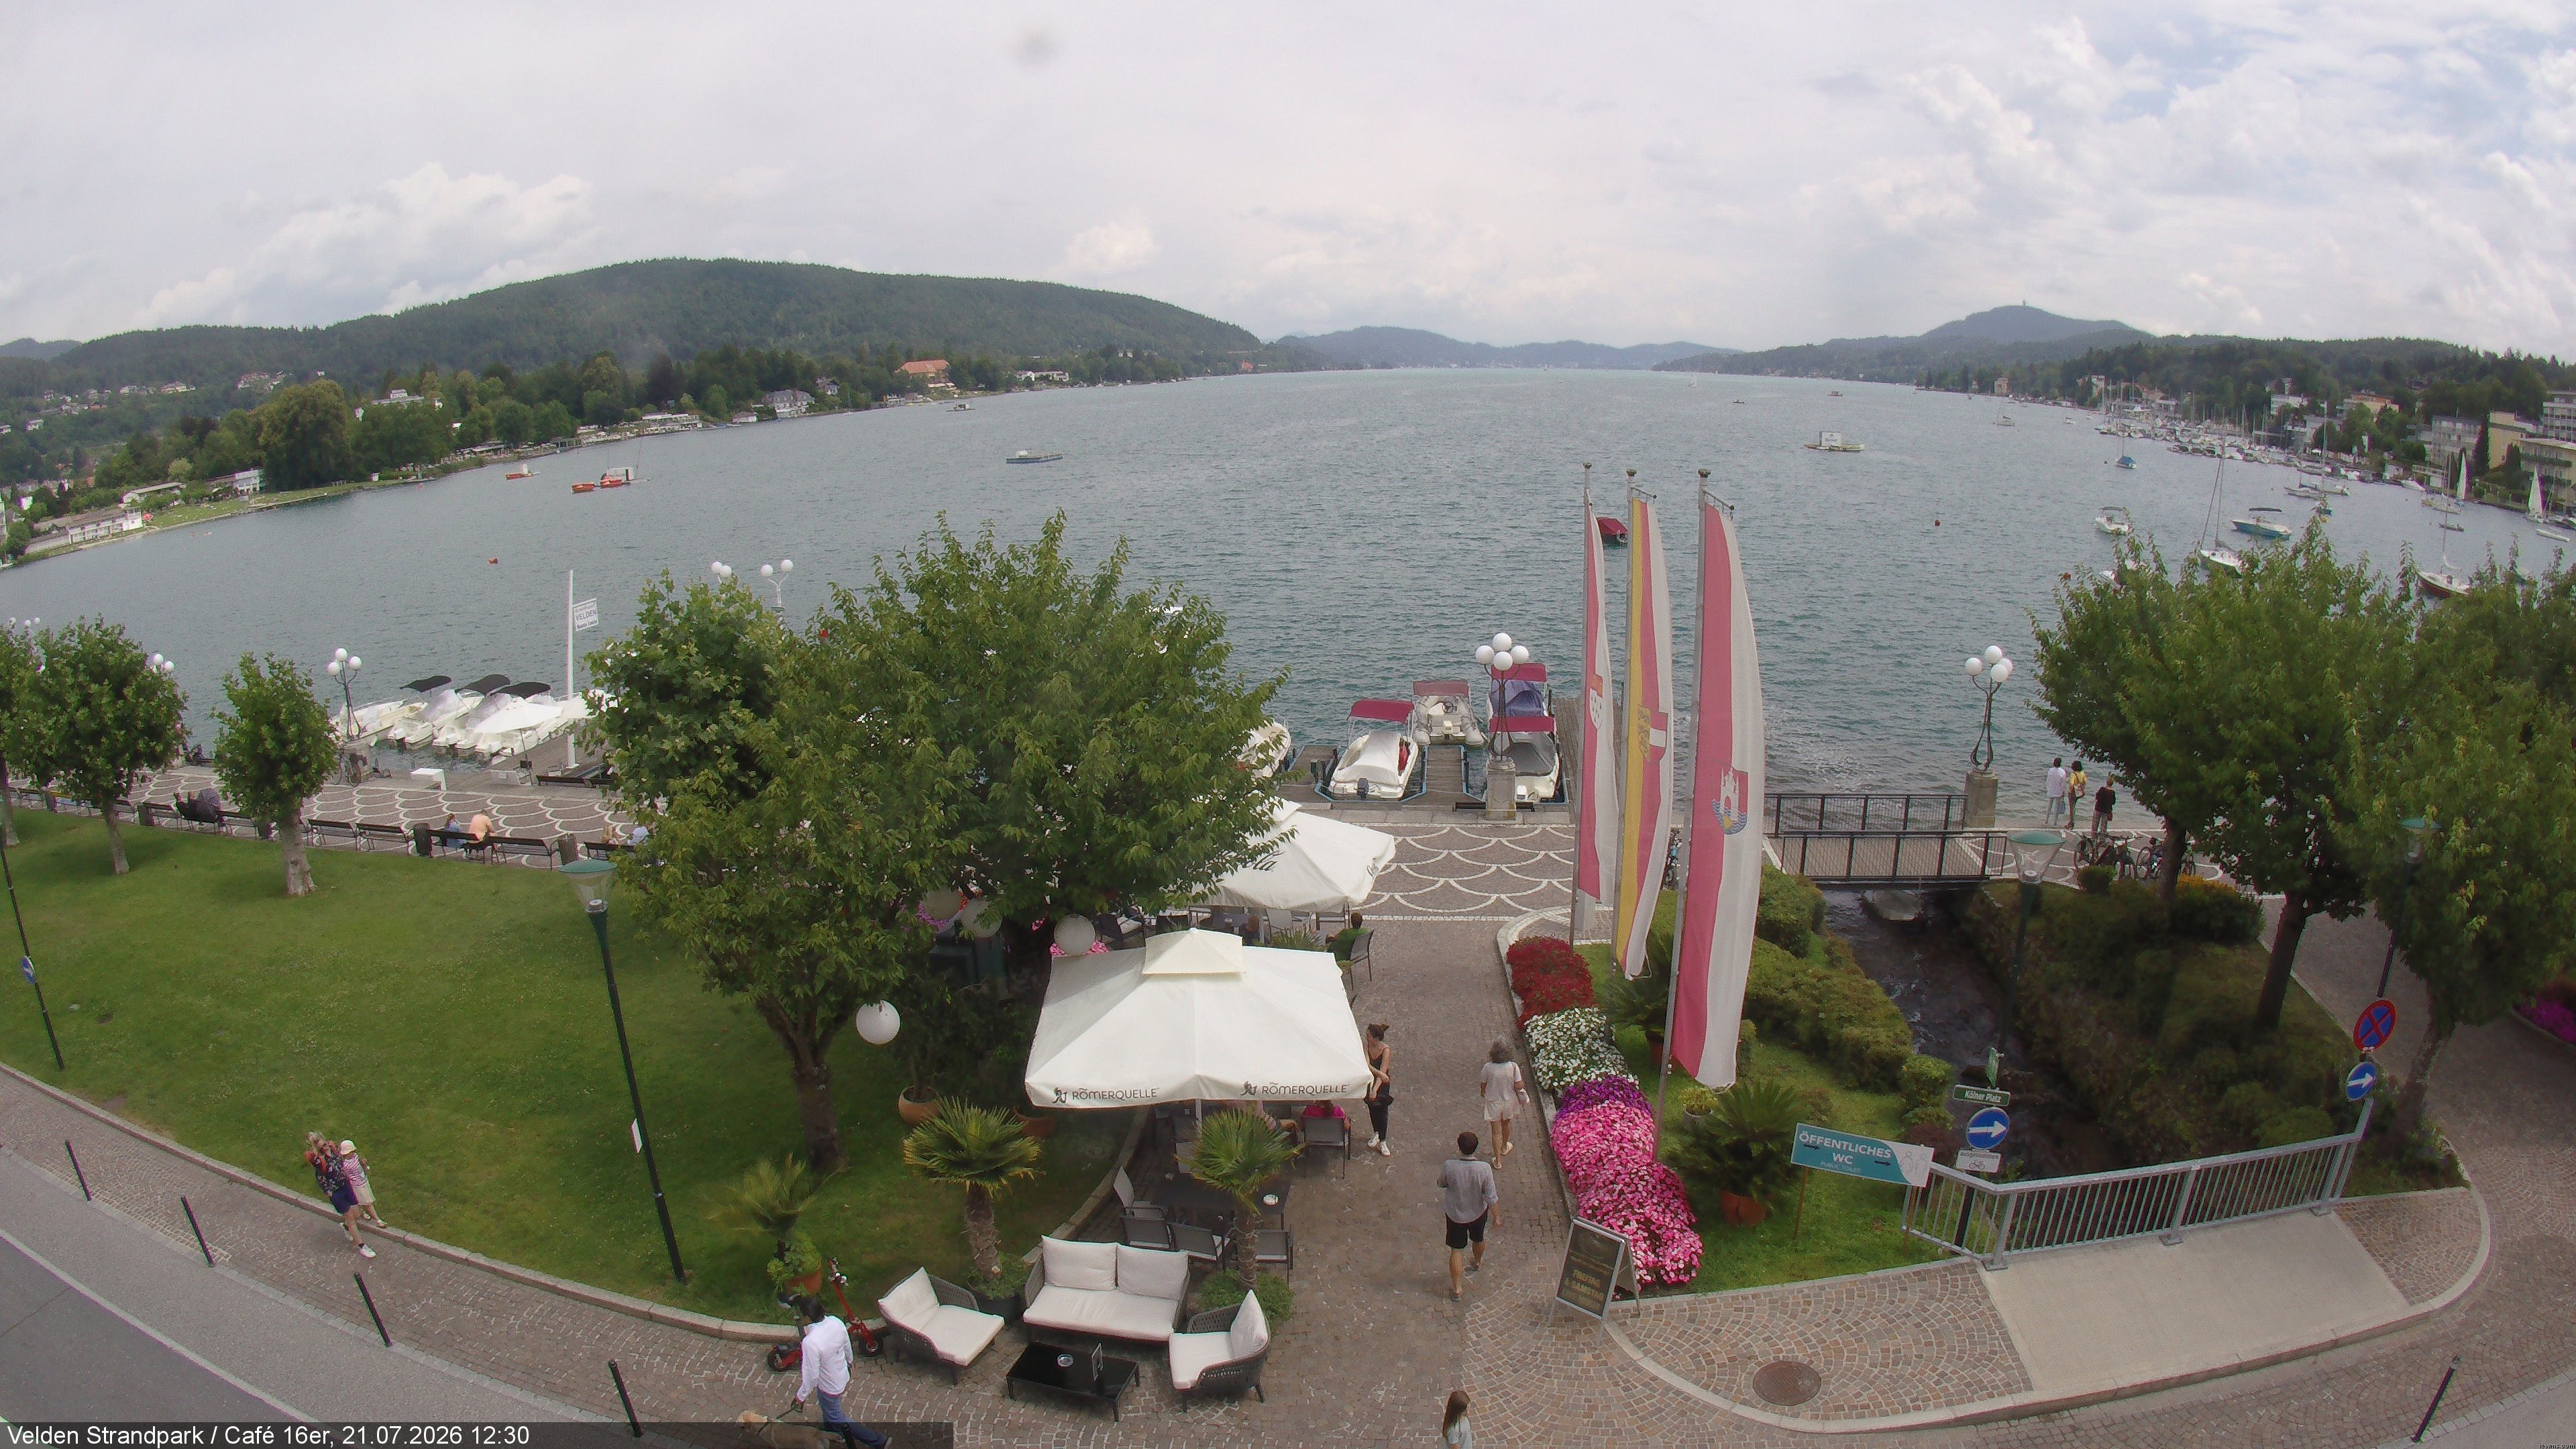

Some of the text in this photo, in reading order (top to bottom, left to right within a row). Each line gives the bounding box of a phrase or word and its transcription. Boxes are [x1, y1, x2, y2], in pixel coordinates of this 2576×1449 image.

[1986, 1093, 2002, 1103] Platz
[1799, 1130, 1892, 1159] ÖFFENTLICHES
[1832, 1152, 1854, 1165] WC
